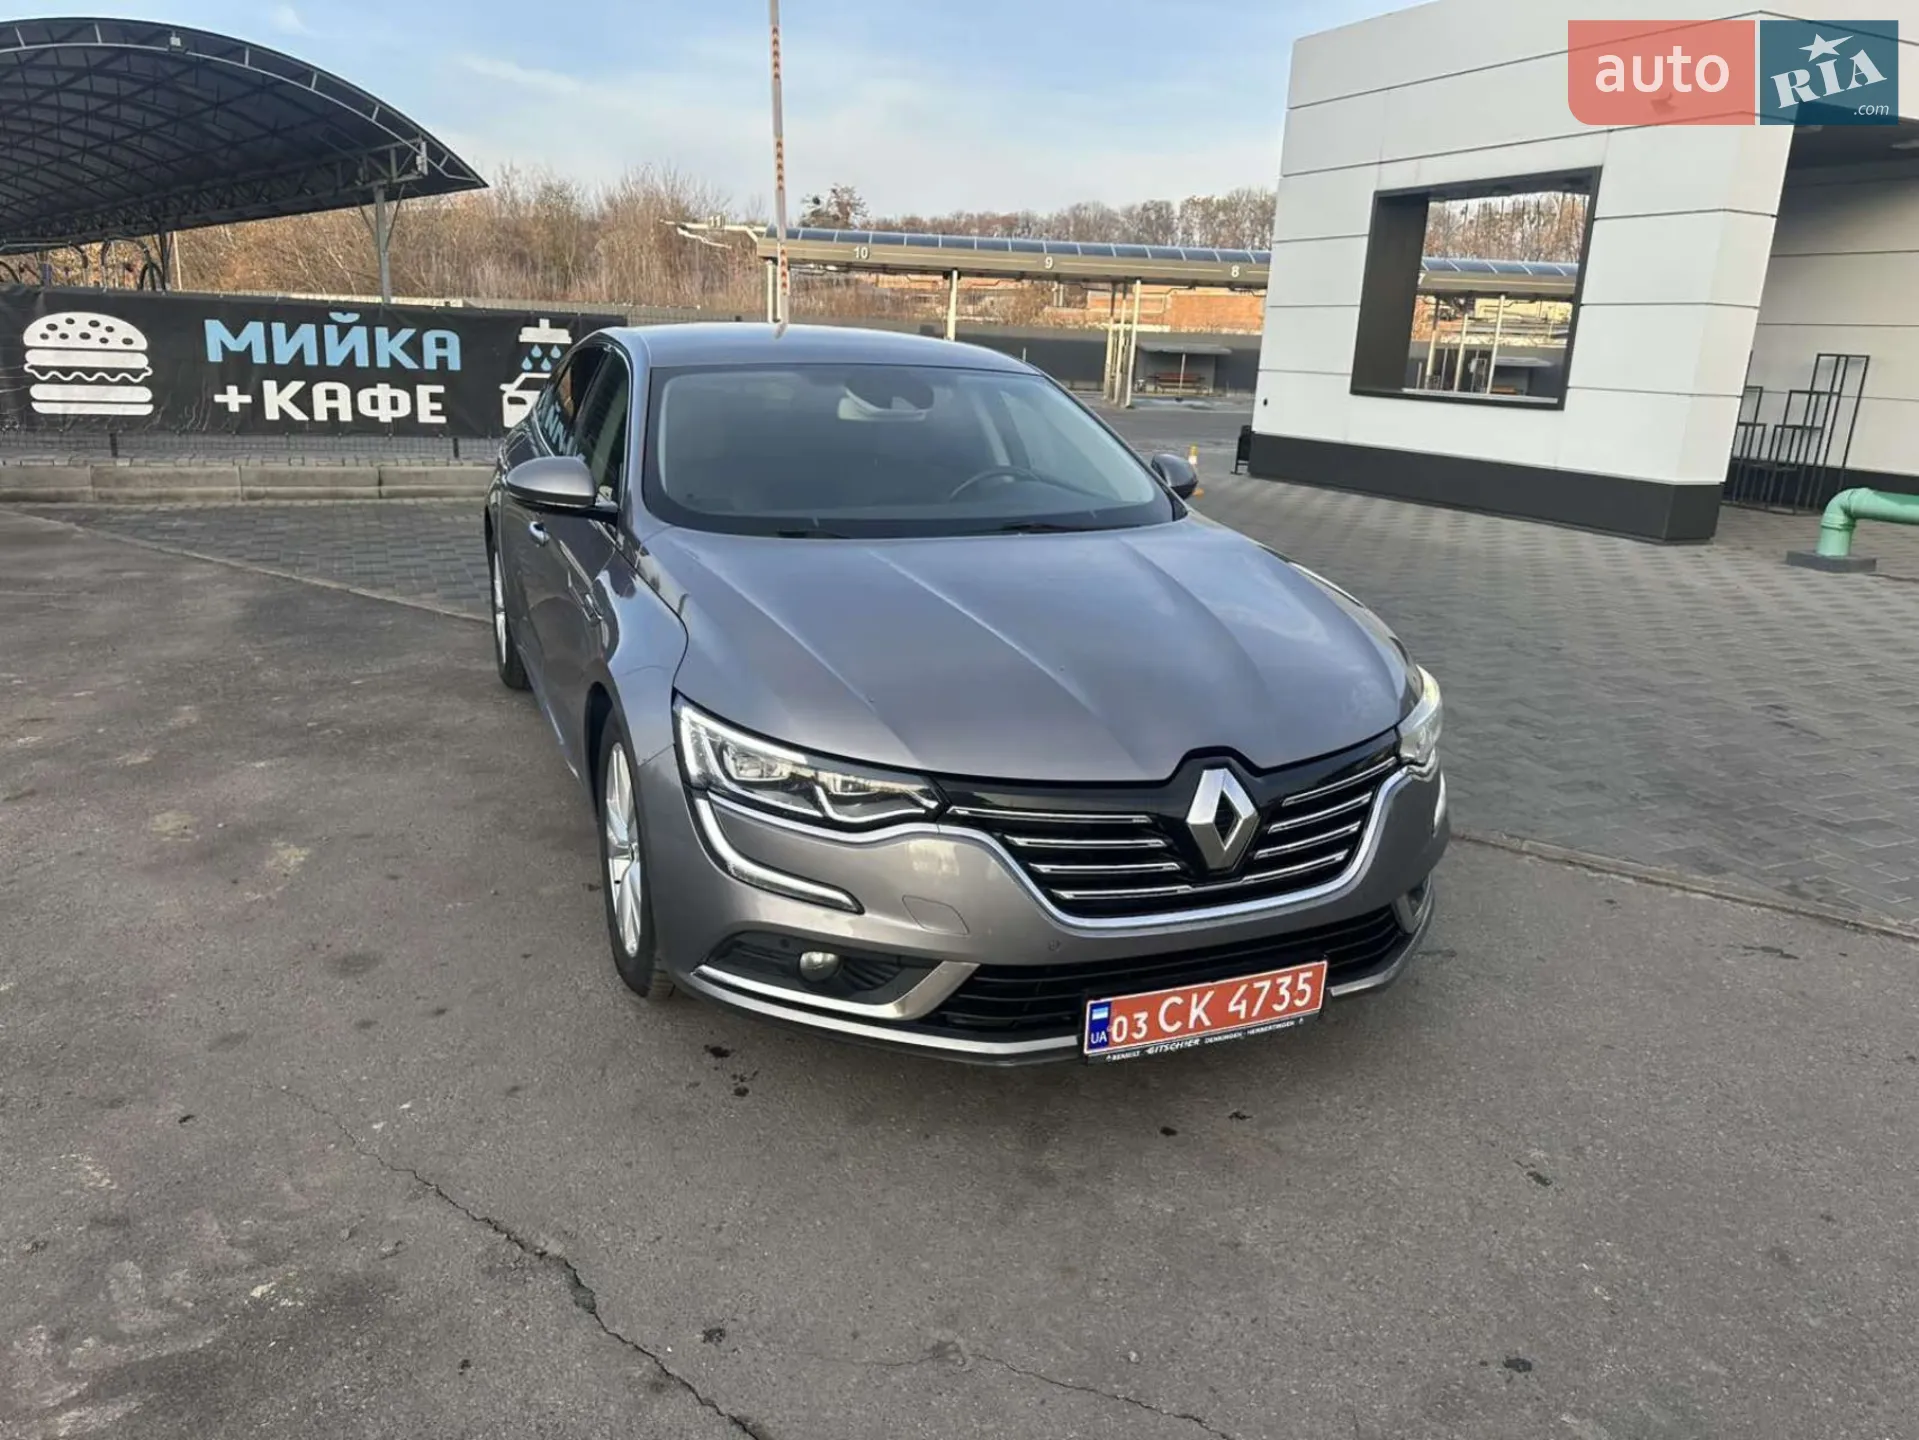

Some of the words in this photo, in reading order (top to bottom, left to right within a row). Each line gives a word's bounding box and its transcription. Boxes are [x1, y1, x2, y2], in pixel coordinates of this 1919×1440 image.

[853, 246, 870, 260] 10
[1044, 256, 1054, 270] 9
[1230, 264, 1240, 278] 8
[205, 312, 461, 371] МИЙКА
[1112, 1012, 1149, 1043] 03
[1158, 990, 1215, 1033] CK
[1227, 972, 1313, 1020] 4735
[1090, 1032, 1107, 1044] UA
